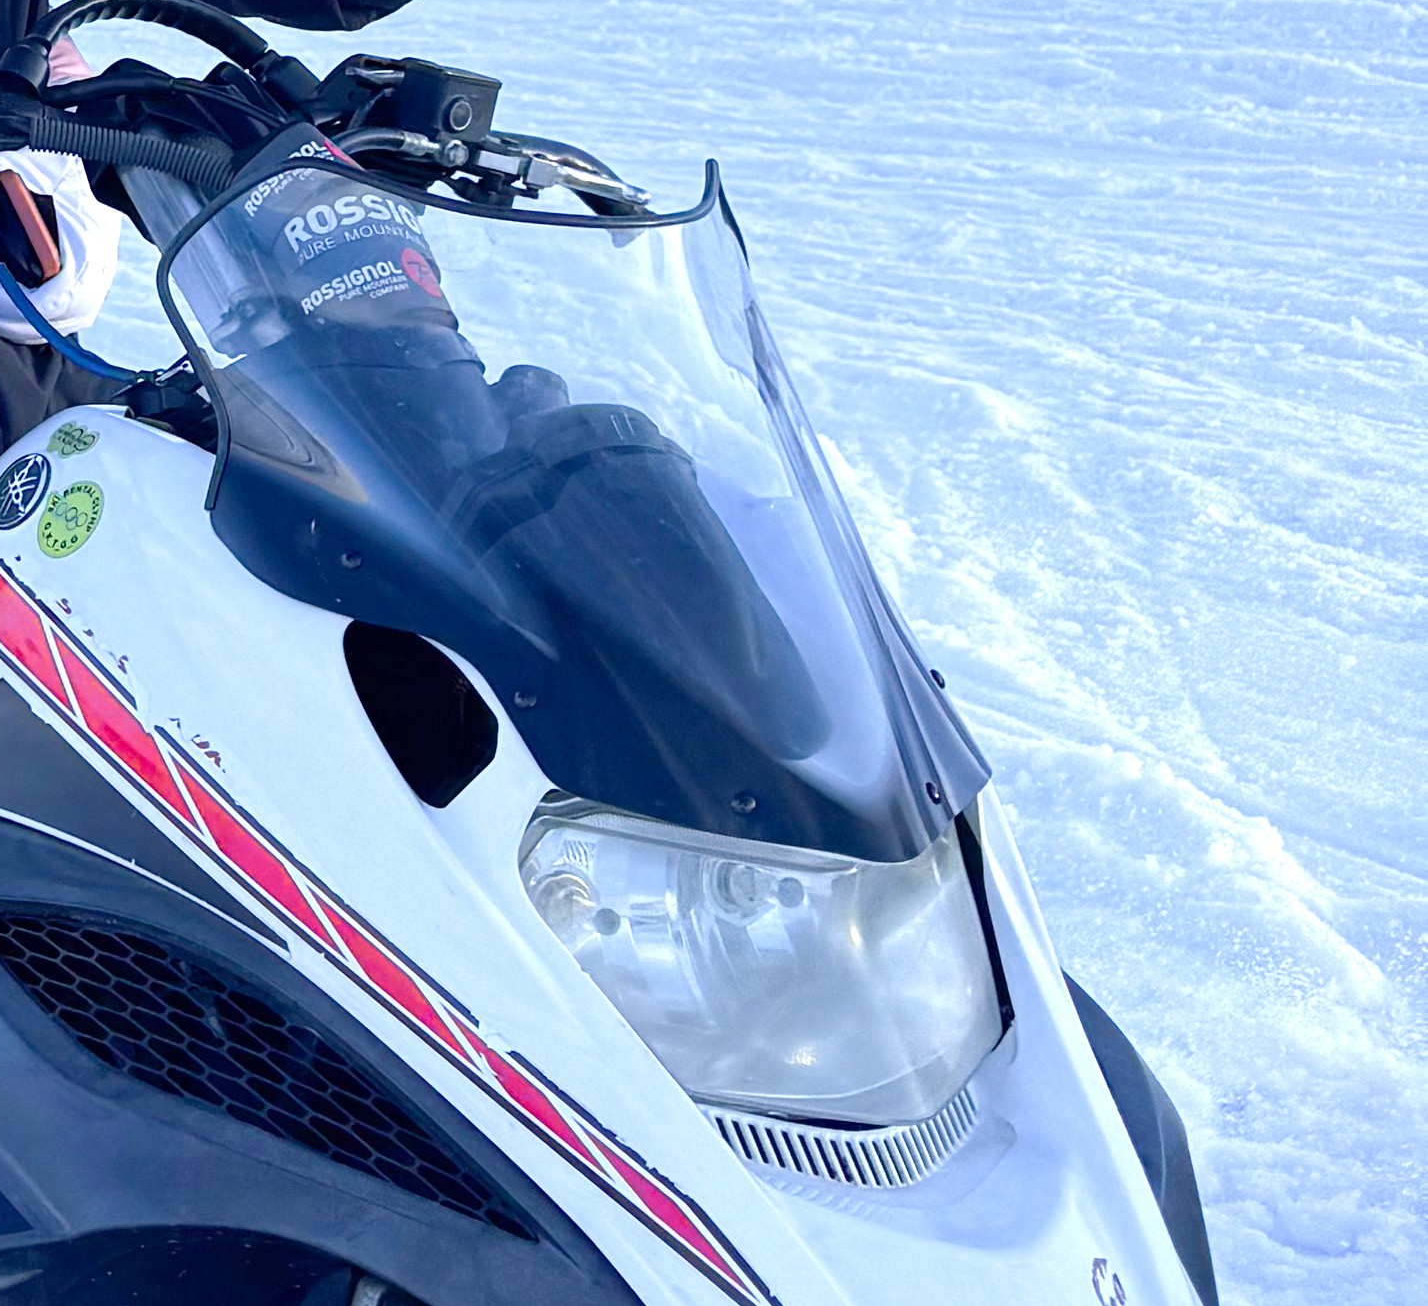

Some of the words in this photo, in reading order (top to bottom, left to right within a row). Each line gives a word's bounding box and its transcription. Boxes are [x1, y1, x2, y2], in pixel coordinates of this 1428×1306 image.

[244, 140, 328, 218] ROSSOL
[301, 260, 403, 315] ROSSIGNOL
[338, 286, 363, 303] PURE
[362, 274, 407, 293] MOUNTAIN
[369, 282, 410, 300] COMPANY
